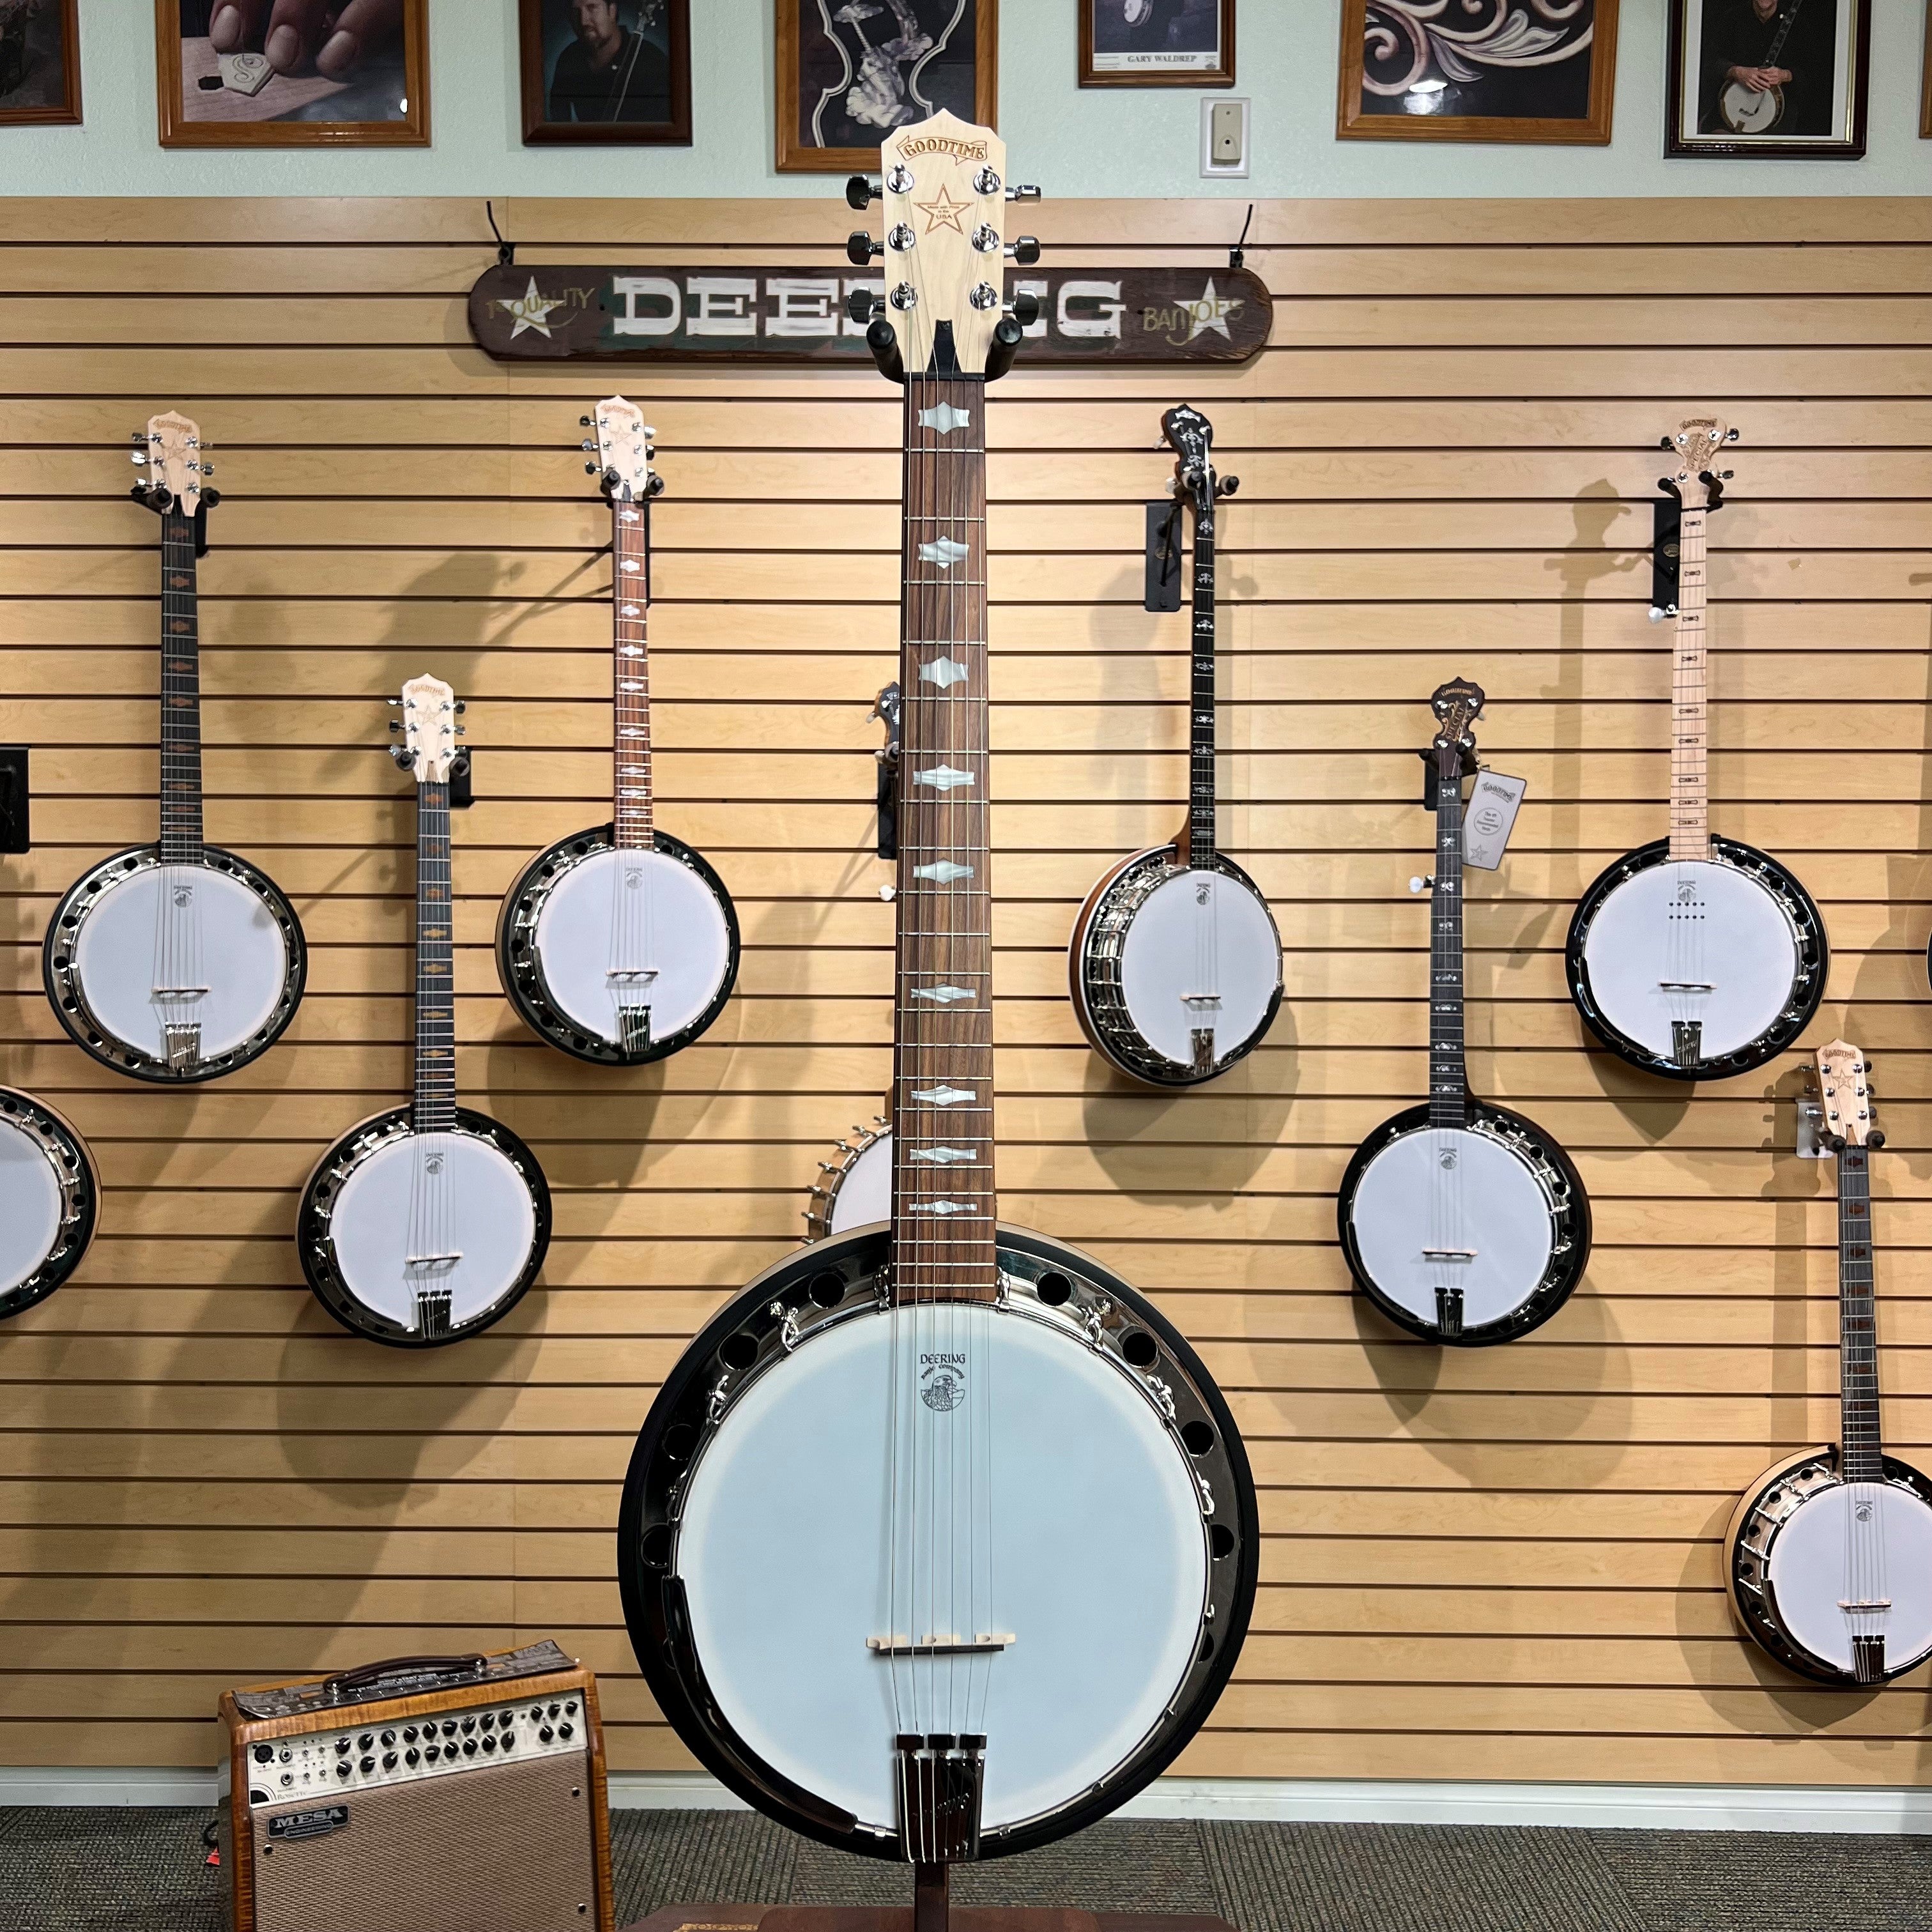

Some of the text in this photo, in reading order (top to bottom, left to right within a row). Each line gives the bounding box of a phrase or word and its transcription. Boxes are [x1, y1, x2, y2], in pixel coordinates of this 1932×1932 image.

[903, 139, 985, 160] GOODTIME
[613, 276, 1127, 339] DEEG
[920, 1353, 965, 1364] DEERING
[273, 1808, 343, 1828] MESA
